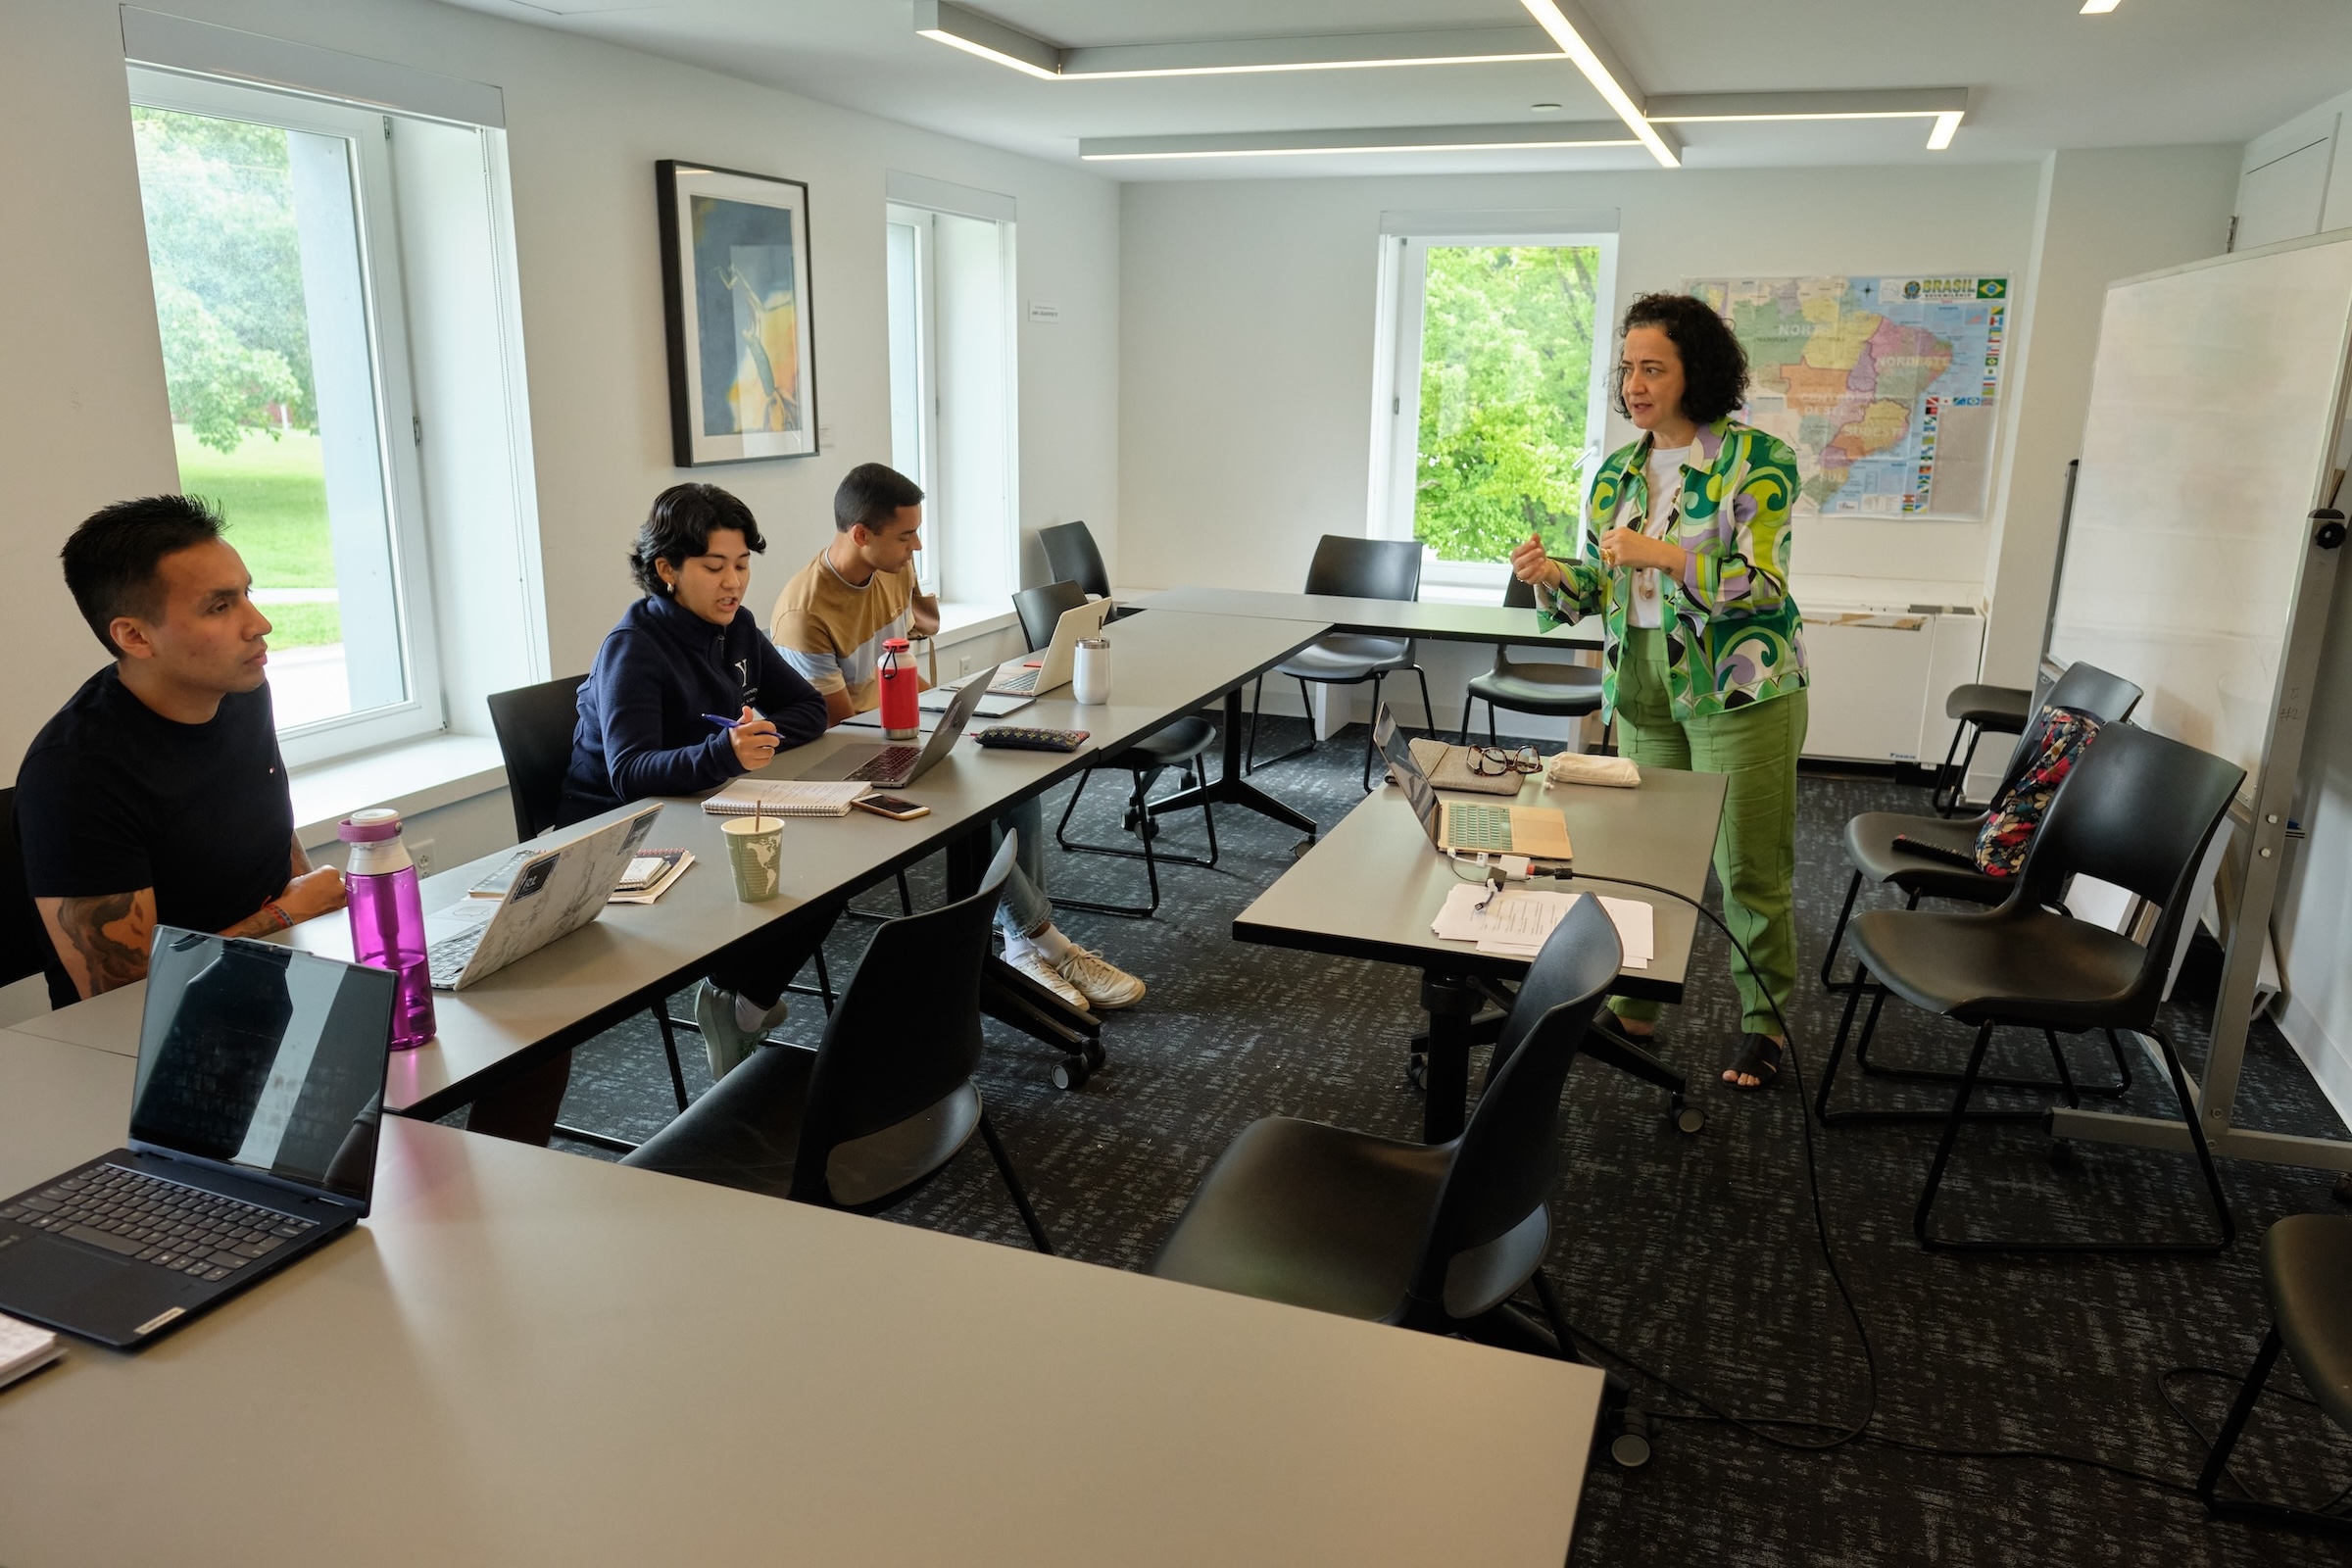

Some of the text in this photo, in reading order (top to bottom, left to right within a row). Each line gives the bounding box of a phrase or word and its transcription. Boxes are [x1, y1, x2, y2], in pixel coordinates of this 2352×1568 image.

[1923, 278, 1976, 293] BRASIL
[1819, 471, 1845, 483] SUL
[735, 659, 748, 688] Y
